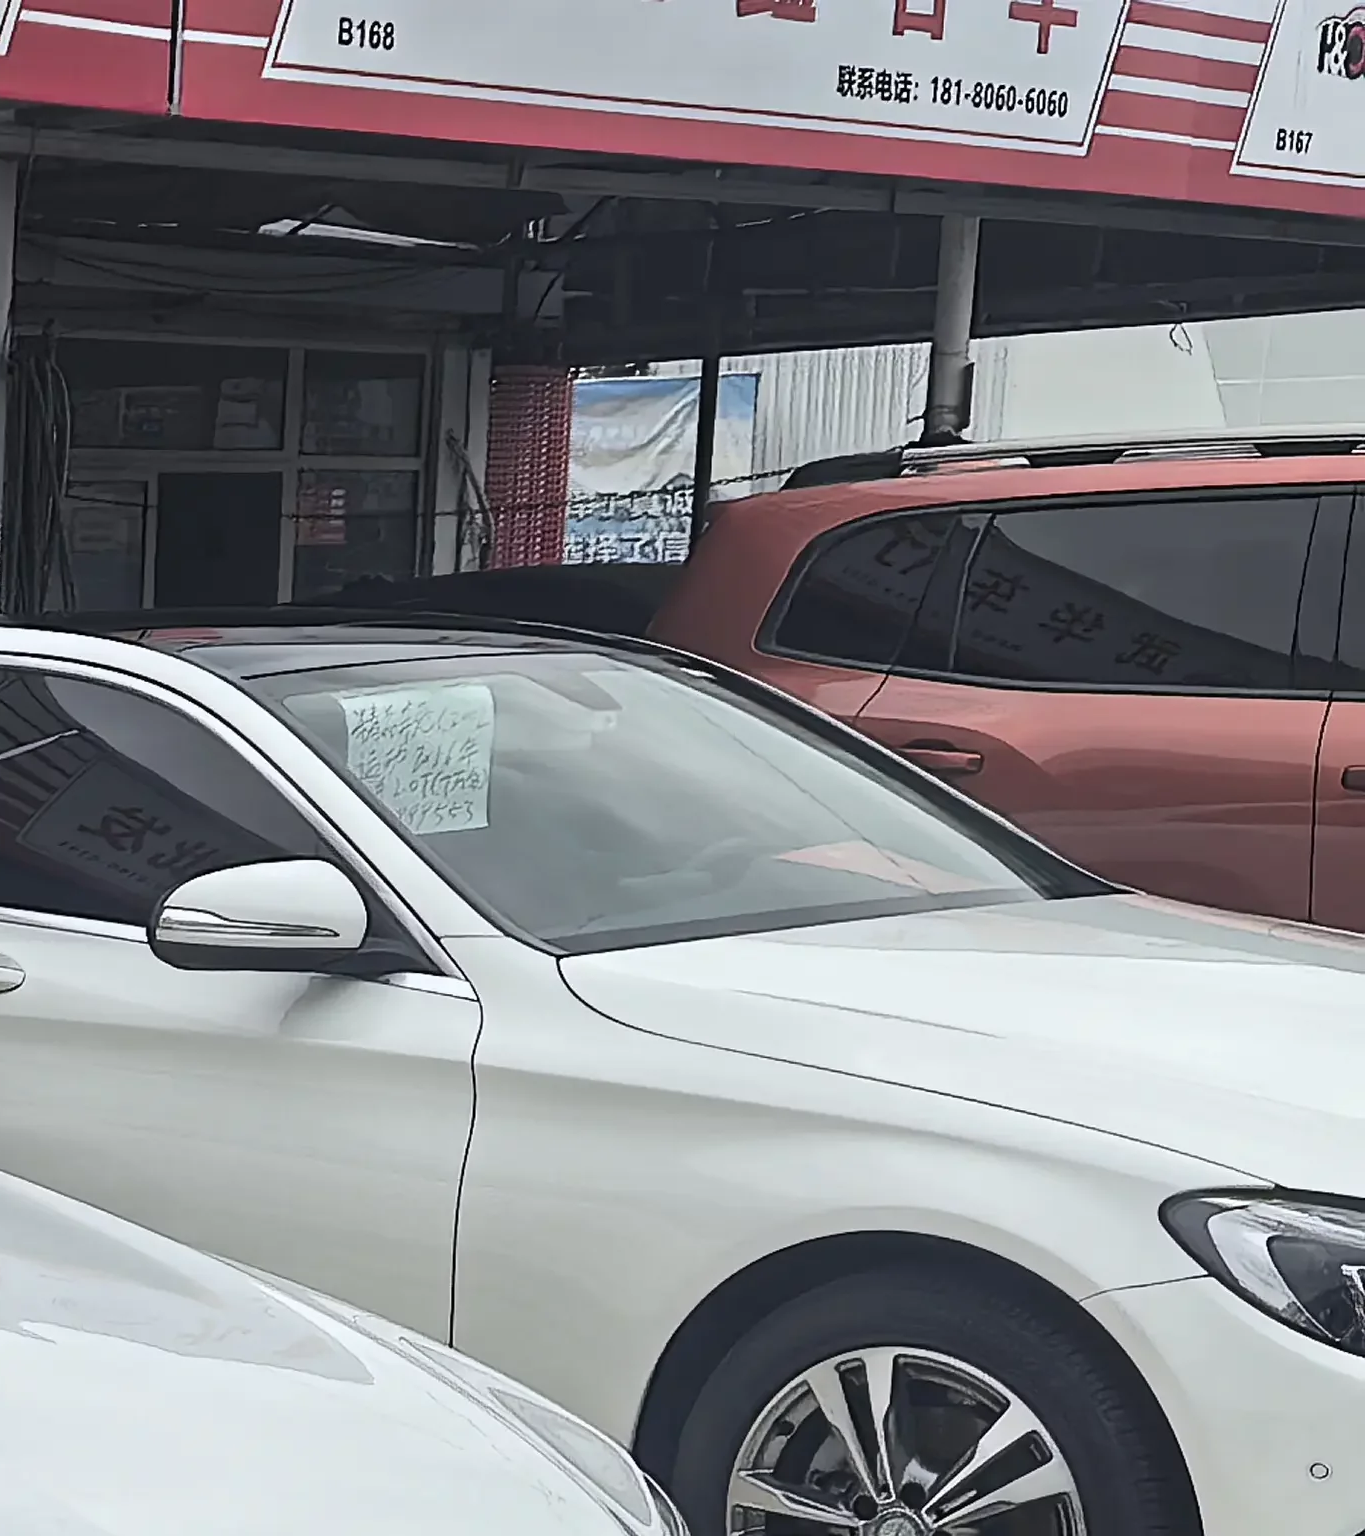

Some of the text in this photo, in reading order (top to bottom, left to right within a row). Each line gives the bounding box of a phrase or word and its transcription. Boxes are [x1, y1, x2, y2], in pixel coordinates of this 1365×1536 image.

[337, 16, 395, 51] B168
[930, 76, 1068, 118] 181-8060-6060
[1275, 128, 1314, 154] B167
